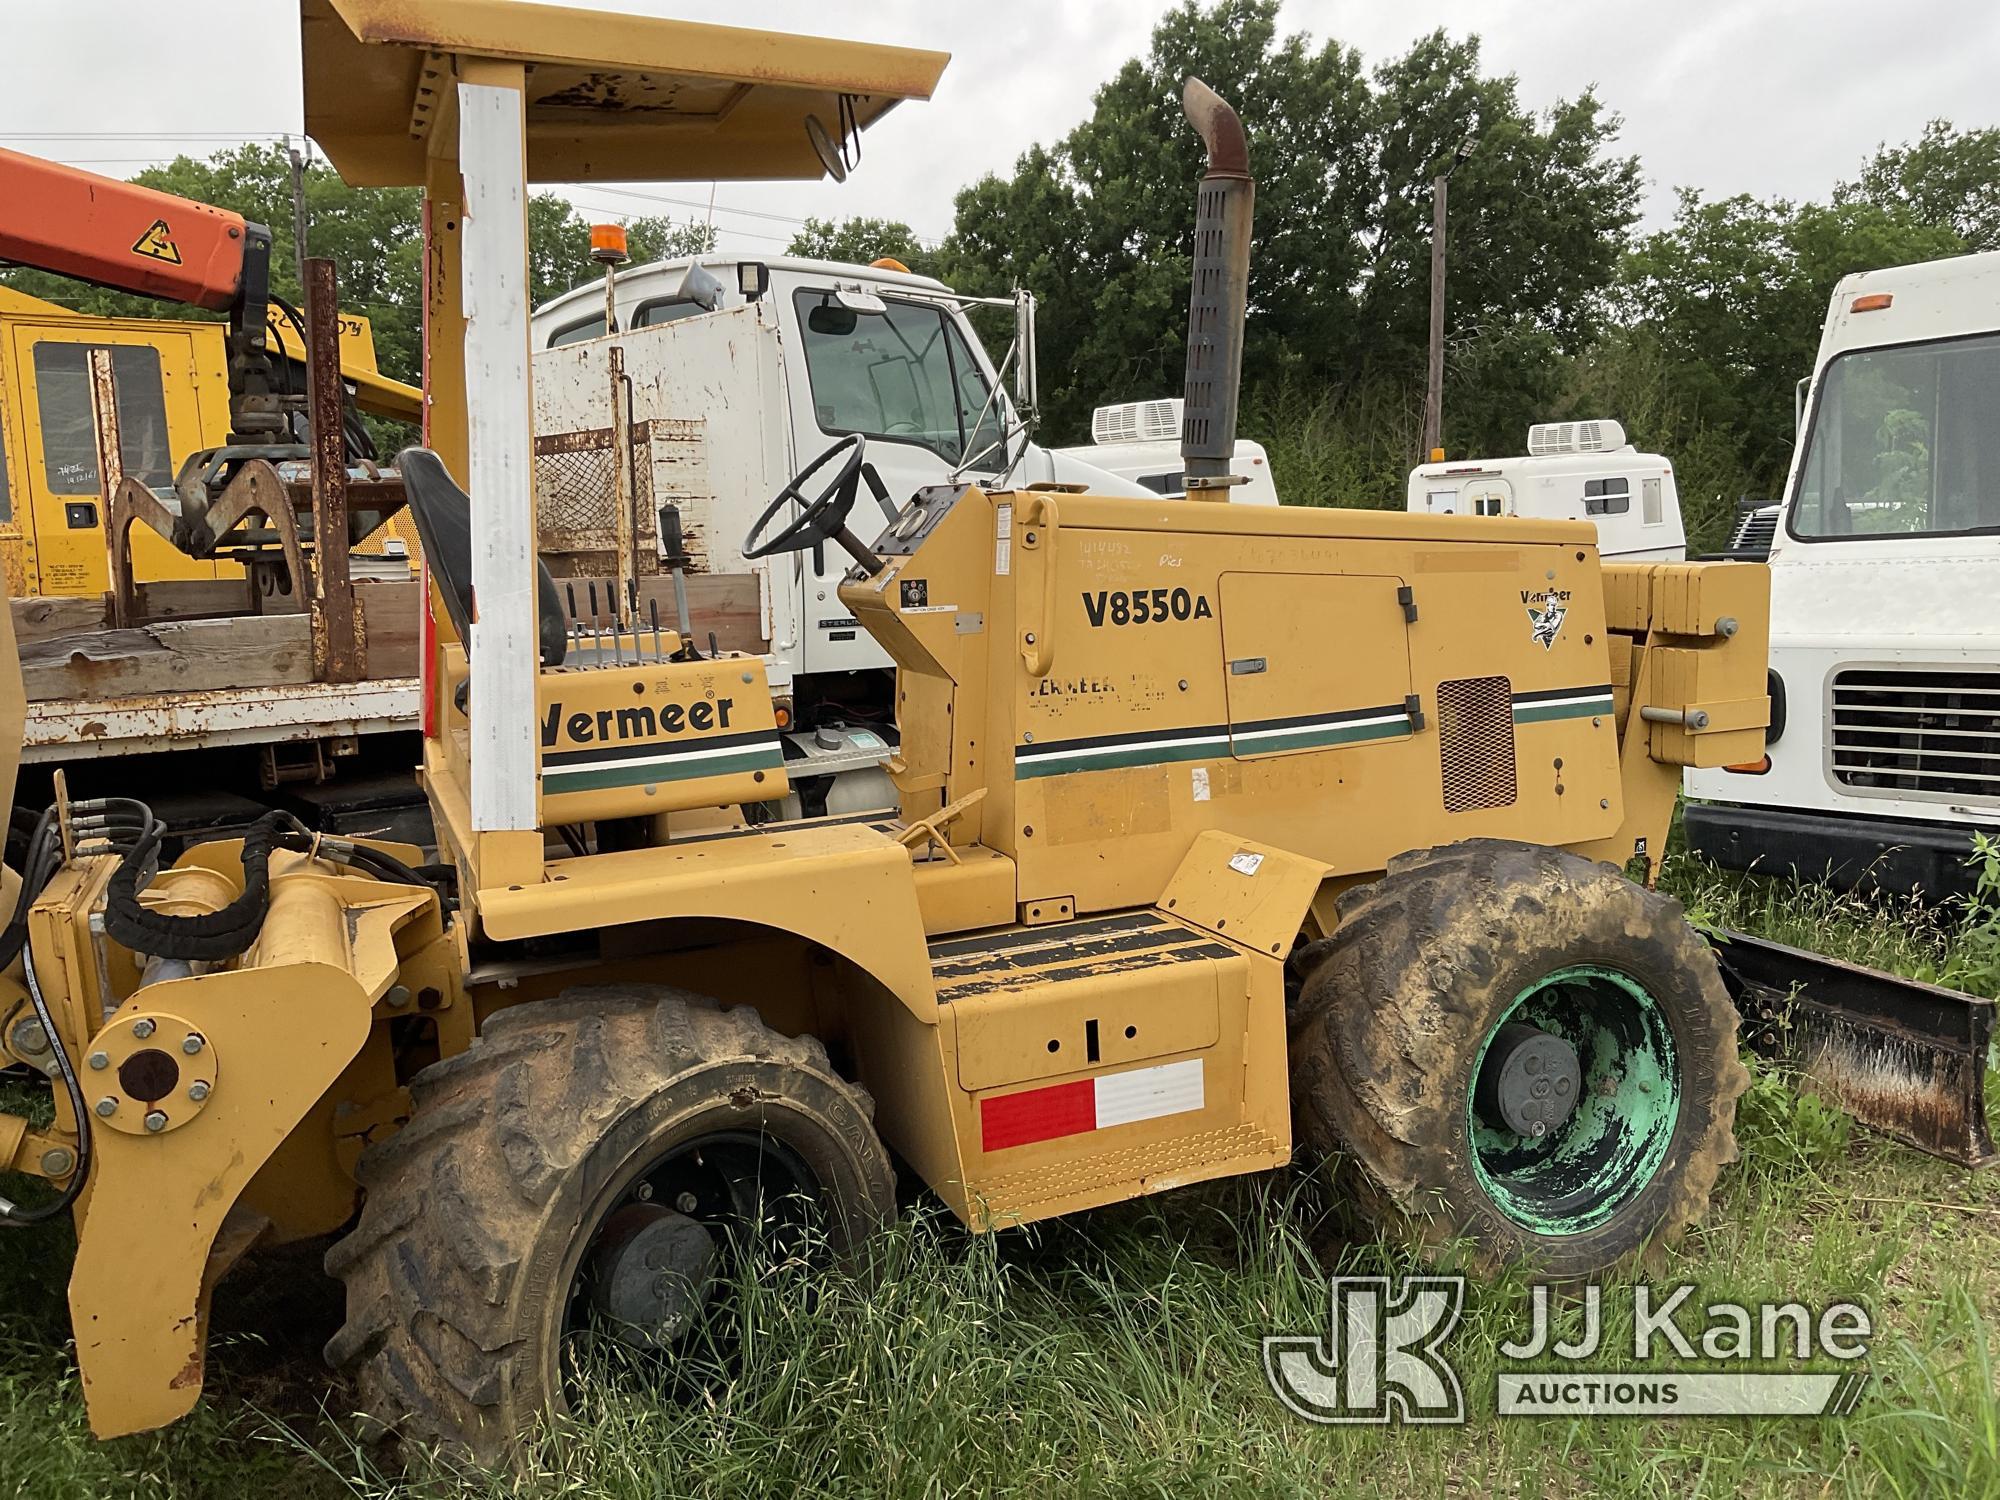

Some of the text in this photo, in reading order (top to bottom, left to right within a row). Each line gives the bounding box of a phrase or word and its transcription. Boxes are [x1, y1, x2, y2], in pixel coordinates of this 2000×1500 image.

[1159, 554, 1183, 568] Pics
[1081, 587, 1213, 628] V8550A
[540, 698, 733, 747] Vermeer
